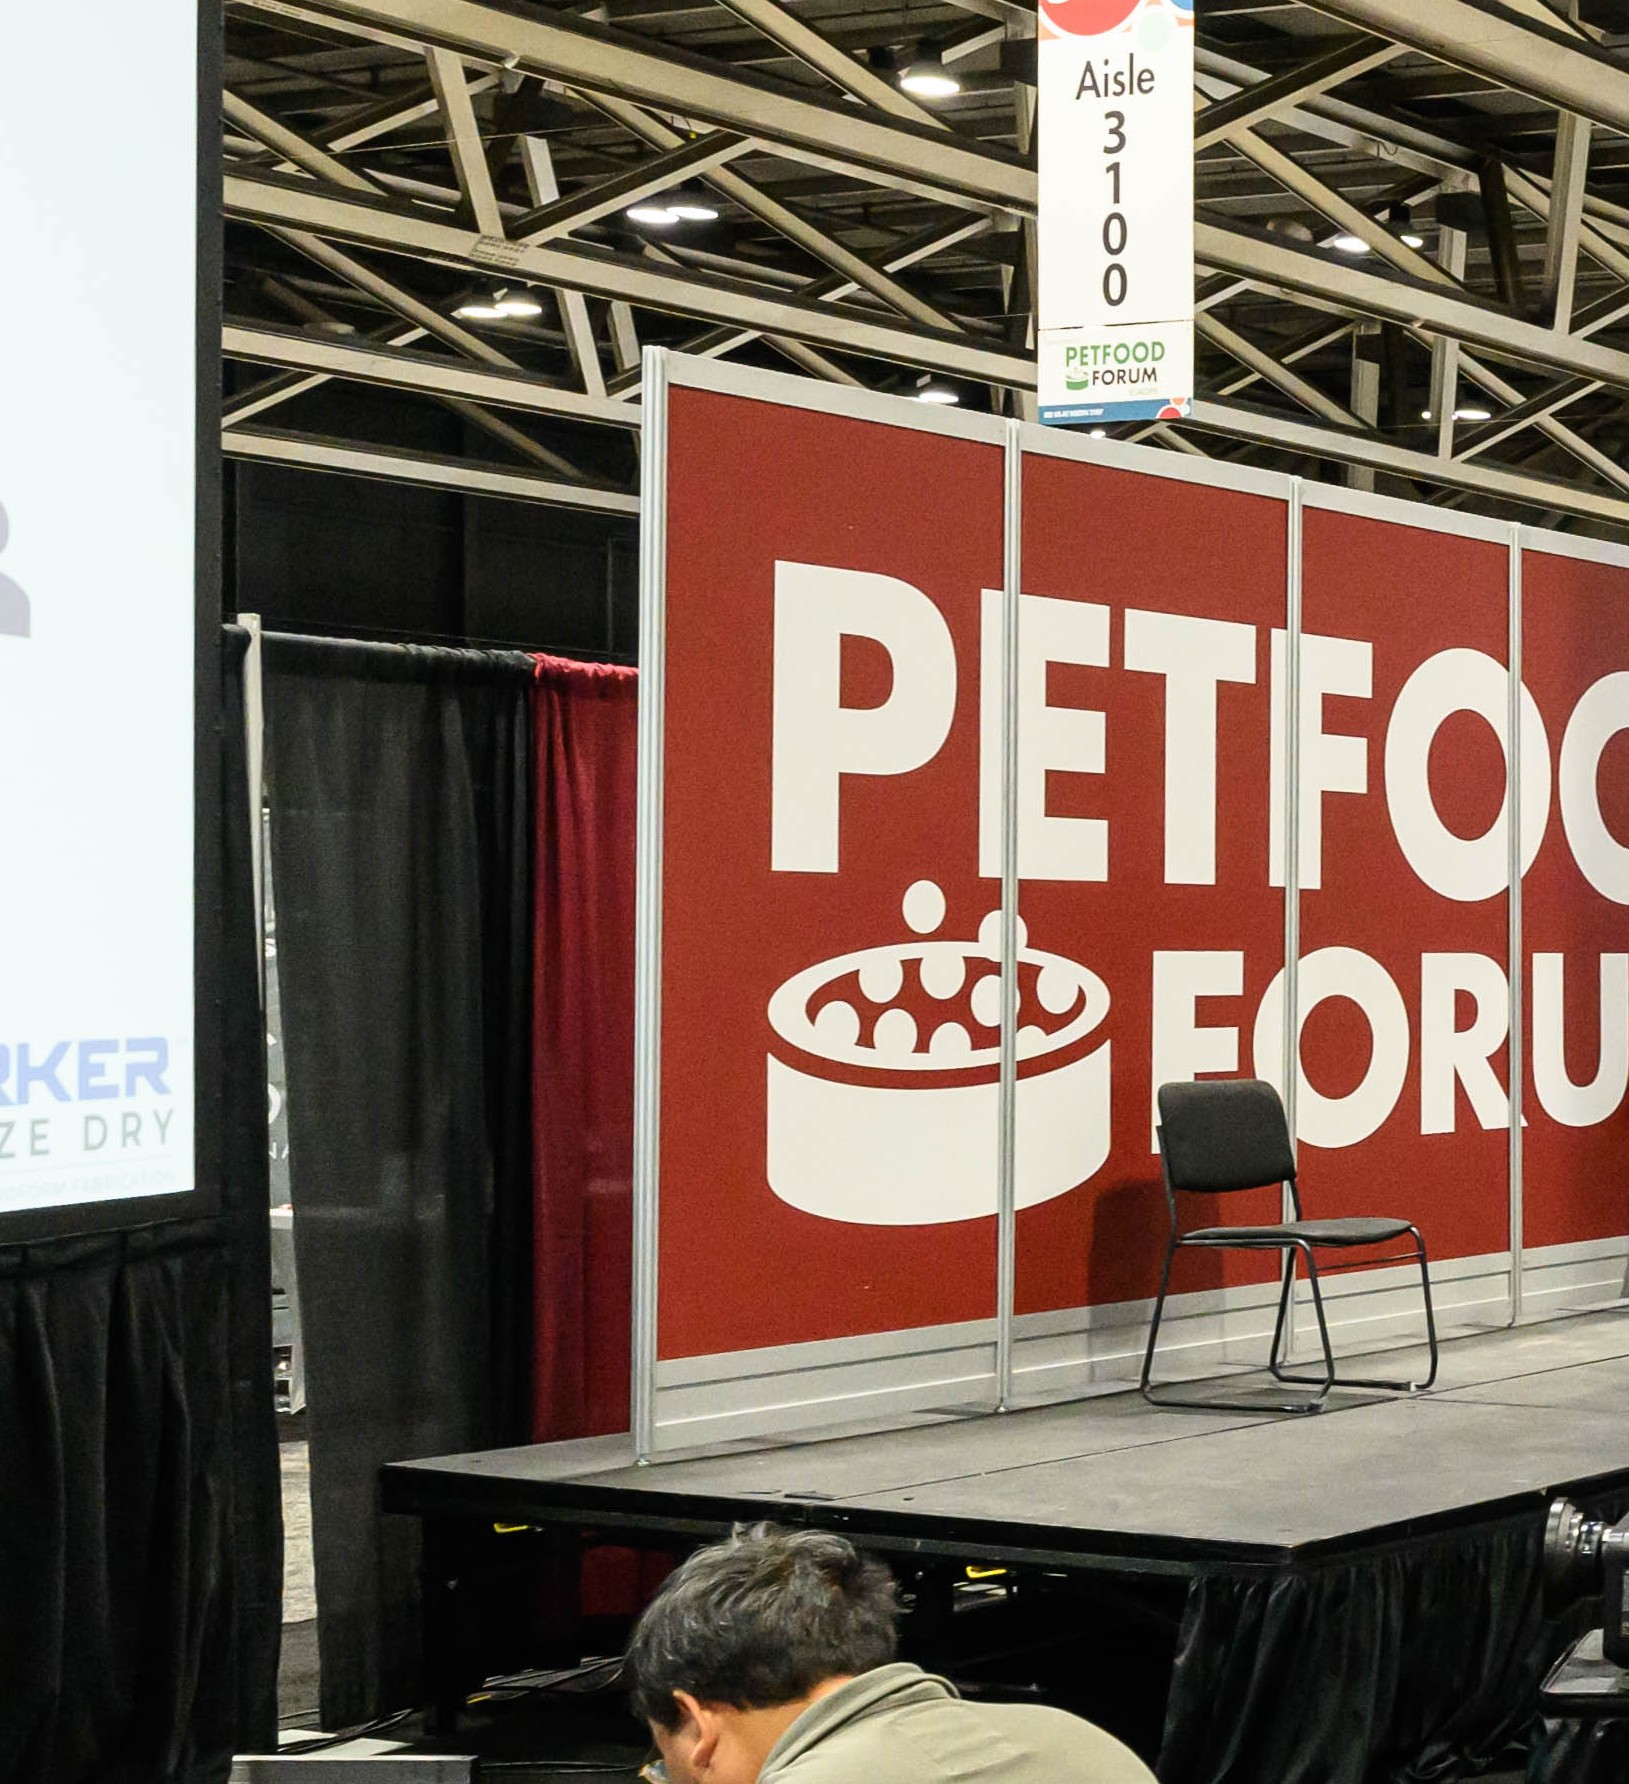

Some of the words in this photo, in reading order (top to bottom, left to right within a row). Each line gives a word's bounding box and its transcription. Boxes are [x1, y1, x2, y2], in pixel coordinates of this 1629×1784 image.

[1076, 53, 1155, 100] Aisle
[1102, 110, 1128, 307] 3100
[1066, 341, 1165, 367] PETFOOD
[1092, 367, 1157, 386] FORUM
[0, 1037, 172, 1106] KER
[83, 1108, 174, 1152] DRY
